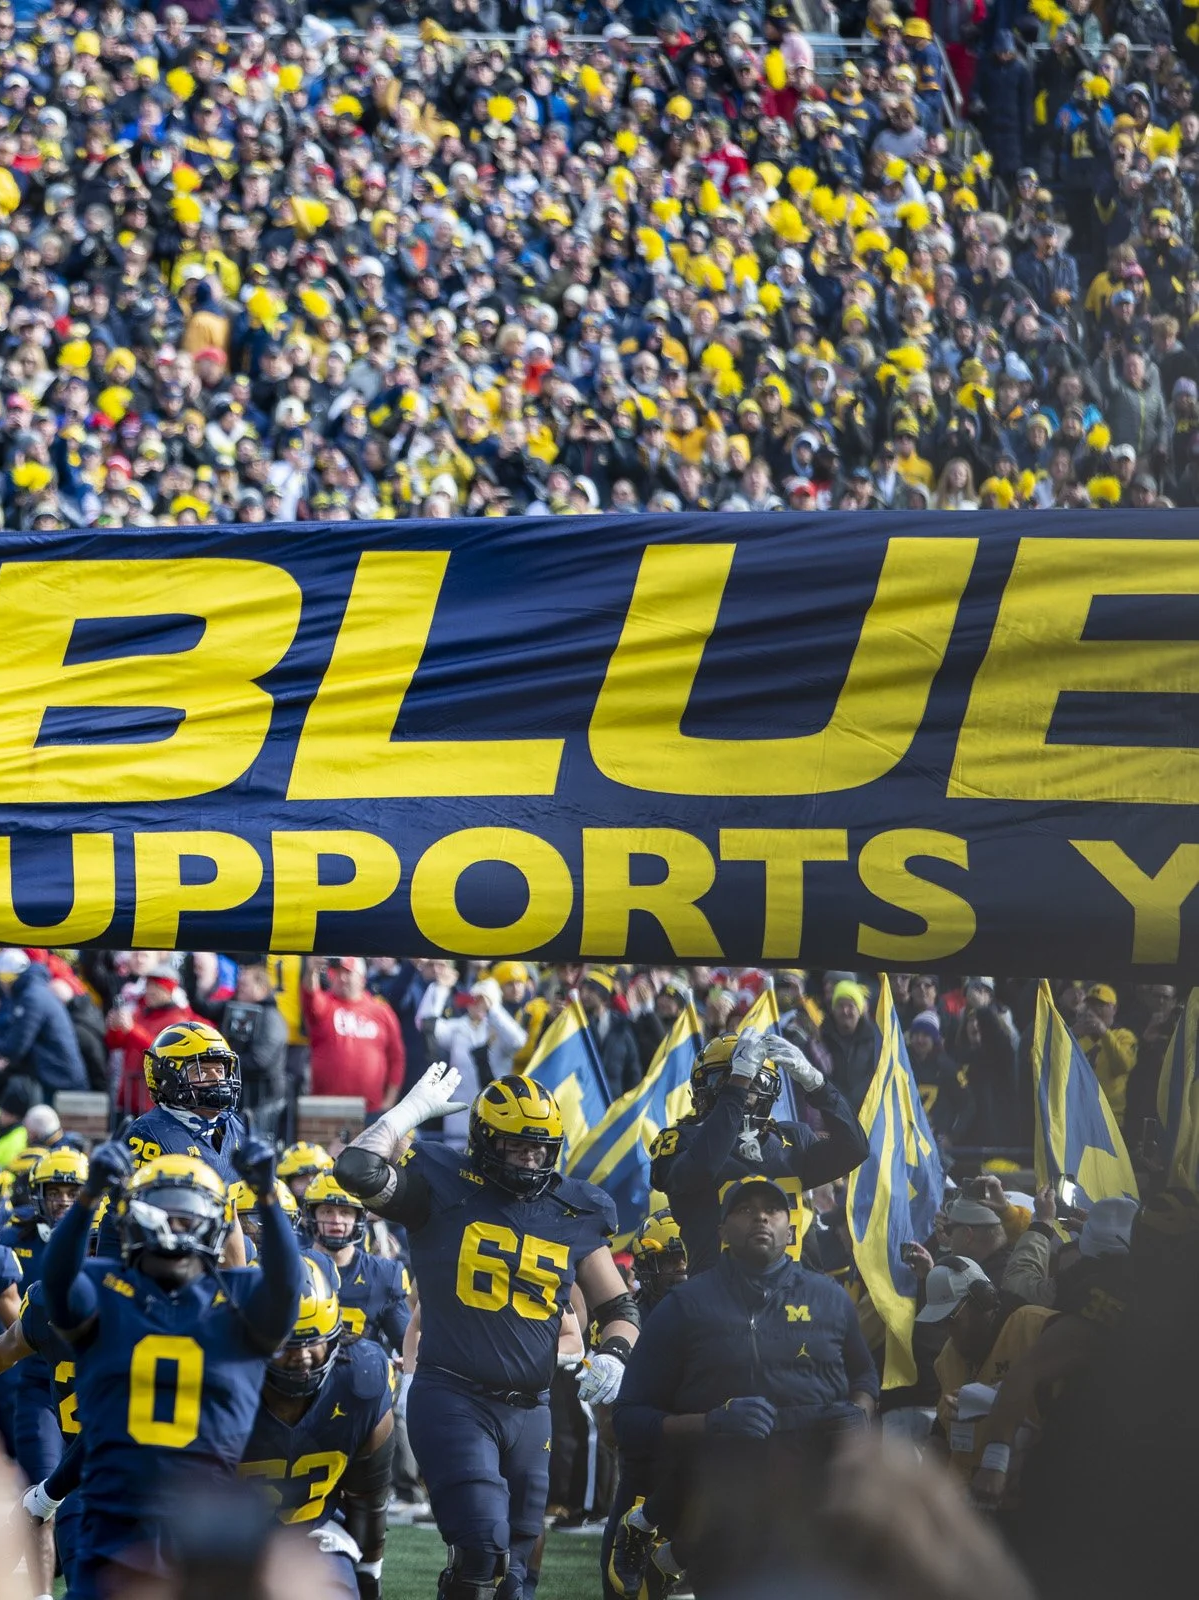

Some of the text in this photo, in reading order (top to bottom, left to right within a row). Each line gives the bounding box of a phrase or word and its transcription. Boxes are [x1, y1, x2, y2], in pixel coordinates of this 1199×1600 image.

[456, 1221, 569, 1320] 65
[785, 1305, 811, 1321] M
[127, 1334, 204, 1448] 0
